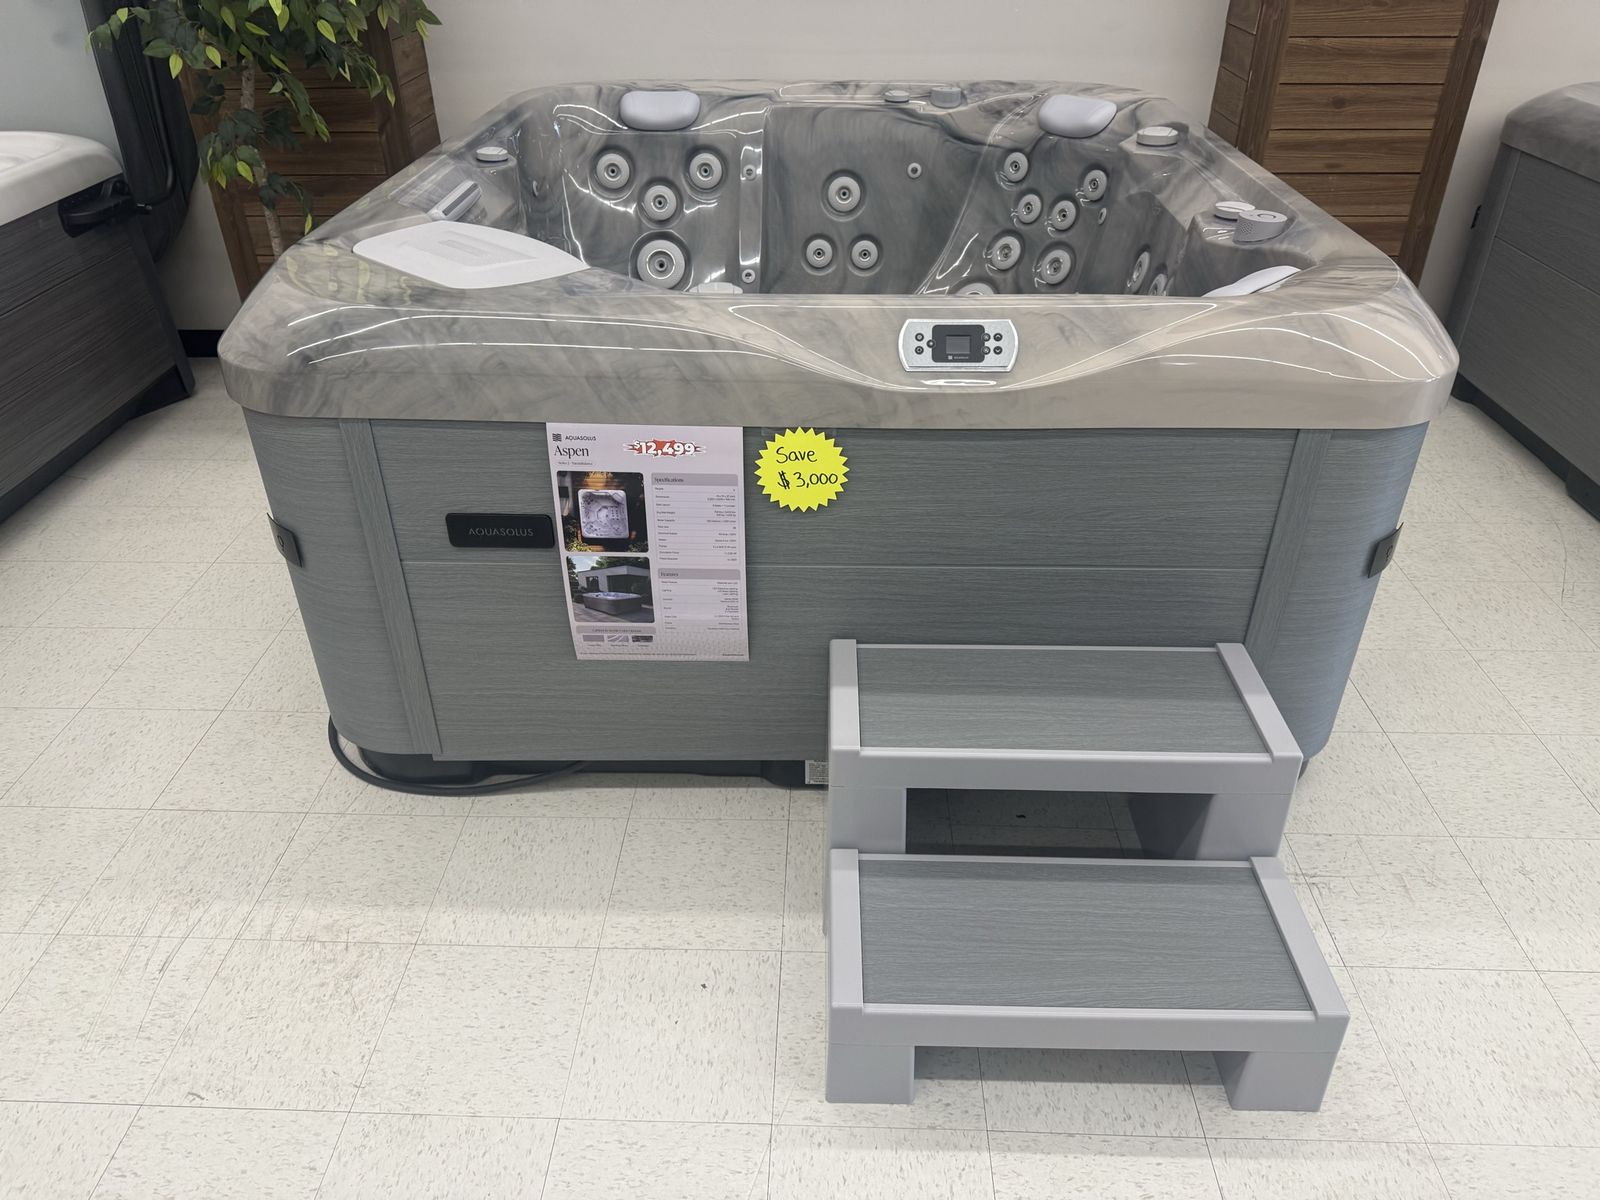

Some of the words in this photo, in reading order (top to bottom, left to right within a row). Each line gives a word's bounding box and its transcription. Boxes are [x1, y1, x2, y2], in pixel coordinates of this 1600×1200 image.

[554, 445, 590, 459] Aspen
[634, 440, 696, 457] $12,499
[776, 446, 818, 464] Save
[468, 527, 535, 537] AQUASOLUS
